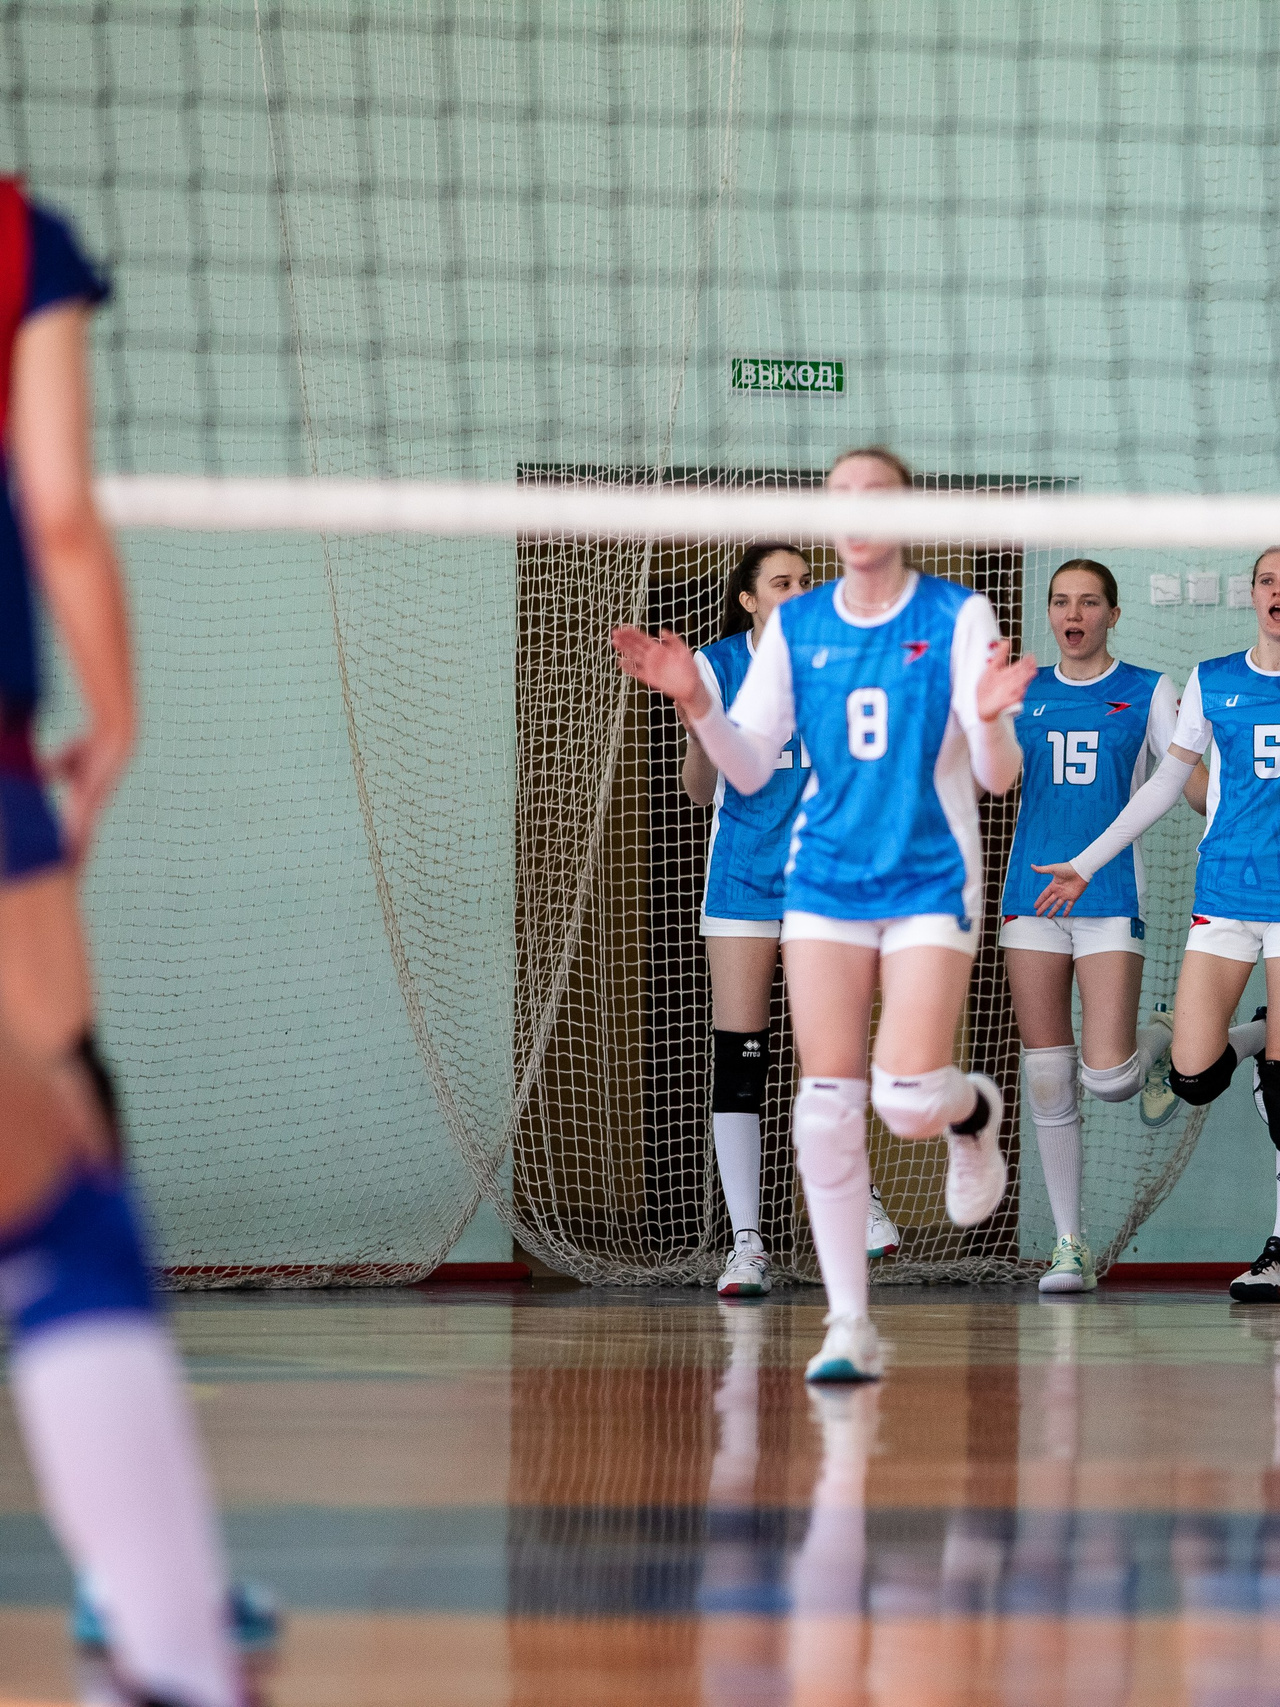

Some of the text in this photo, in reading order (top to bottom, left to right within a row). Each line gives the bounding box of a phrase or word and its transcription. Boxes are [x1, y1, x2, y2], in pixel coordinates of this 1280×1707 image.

[741, 363, 834, 389] ВЫХОД
[846, 686, 888, 761] 8
[1046, 730, 1100, 786] 15
